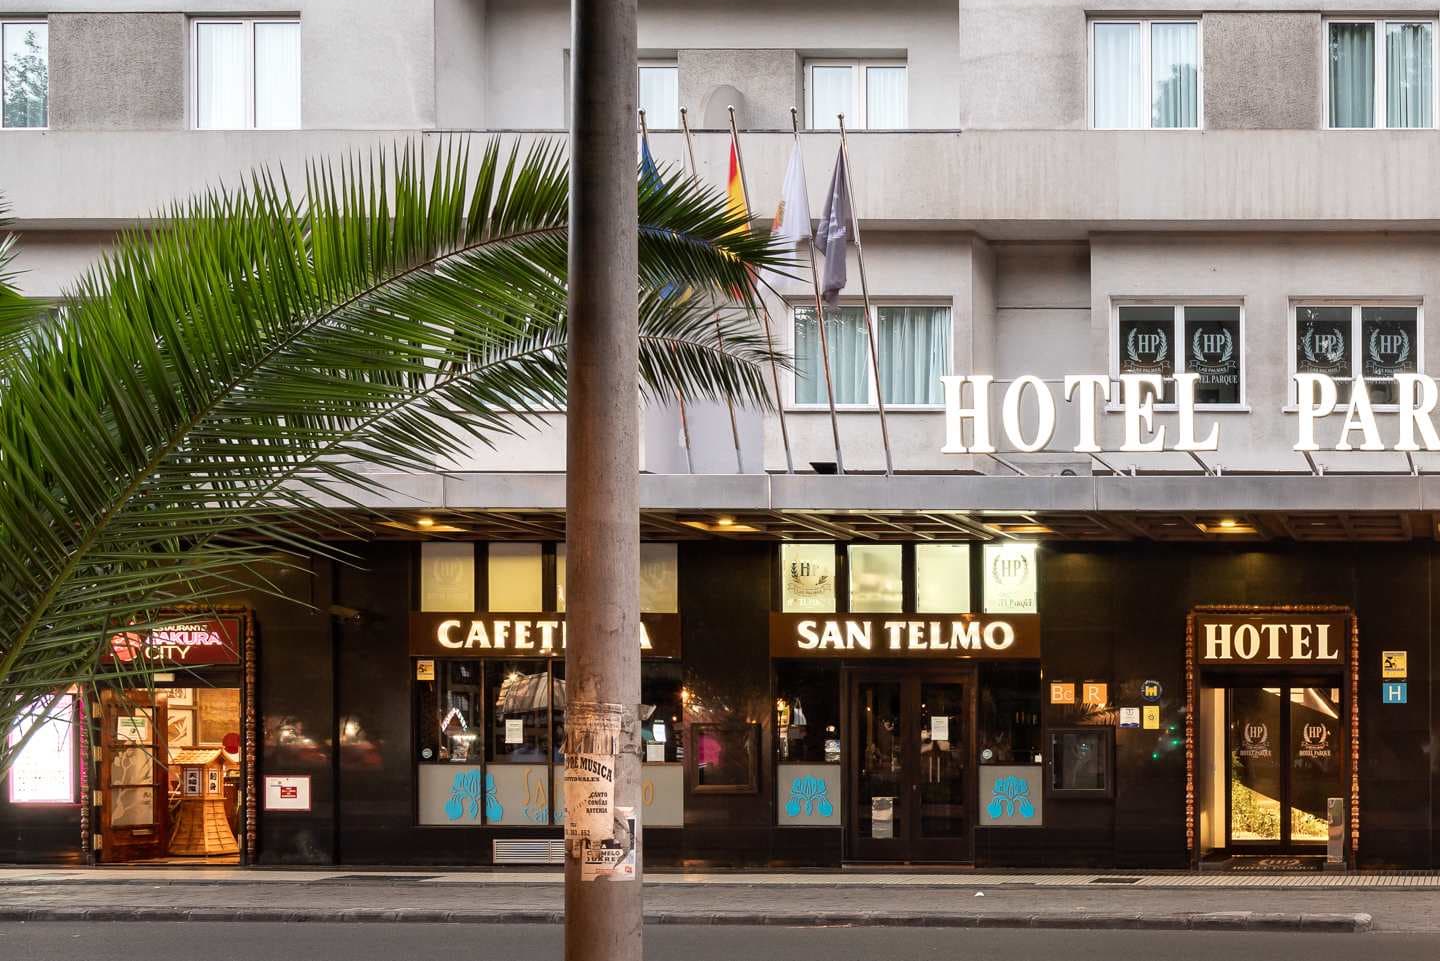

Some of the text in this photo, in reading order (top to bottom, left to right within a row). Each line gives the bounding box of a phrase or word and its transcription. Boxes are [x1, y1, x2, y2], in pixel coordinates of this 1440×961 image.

[1137, 334, 1160, 353] HP
[1202, 334, 1226, 353] HP
[1379, 334, 1403, 354] HP
[1211, 374, 1238, 385] PARQUE
[940, 374, 1220, 454] HOTEL
[797, 620, 1015, 650] SAN TELMO
[1204, 623, 1339, 660] HOTEL
[145, 645, 191, 660] CITY
[1088, 686, 1101, 701] R
[1389, 685, 1401, 701] H
[1249, 726, 1263, 738] HP
[1308, 726, 1322, 738] HP
